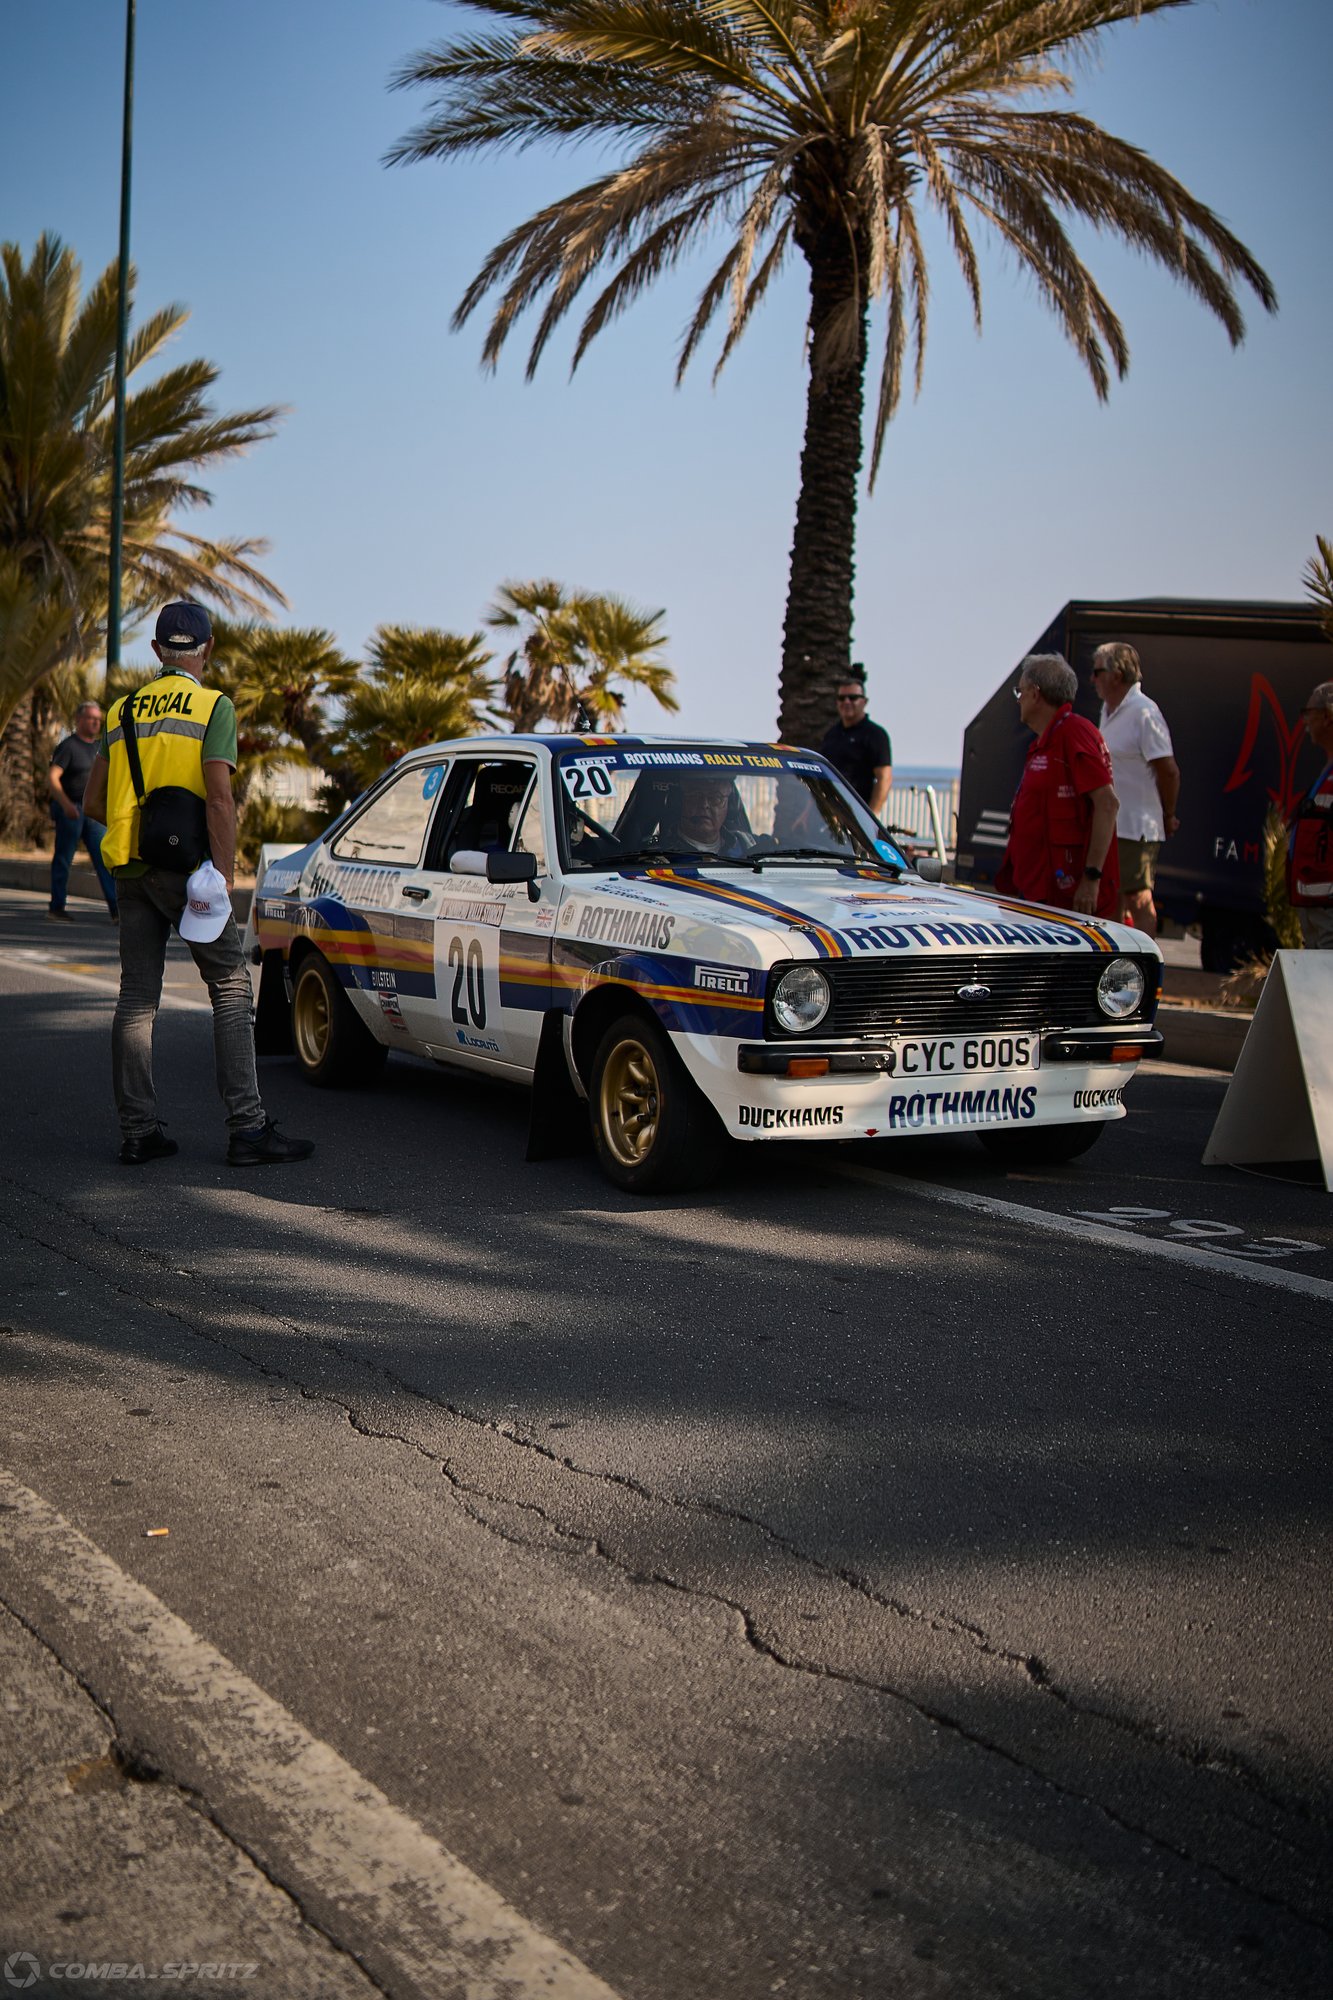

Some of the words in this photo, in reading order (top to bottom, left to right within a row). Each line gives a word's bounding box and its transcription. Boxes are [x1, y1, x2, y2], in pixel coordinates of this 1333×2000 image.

[623, 753, 704, 765] ROTHMANS
[703, 754, 744, 766] RALLY
[743, 755, 783, 769] TEAM
[787, 760, 822, 773] PIRELLI
[428, 772, 439, 791] 3
[490, 783, 526, 794] RECAR
[565, 766, 613, 798] 20
[881, 844, 897, 861] 3
[308, 862, 402, 909] ROTHMANS
[265, 902, 286, 919] PIRELLI
[576, 905, 676, 950] ROTHMANS
[838, 922, 1082, 951] ROTHMANS
[371, 971, 397, 989] BILSTEIN
[448, 936, 487, 1031] 20
[694, 965, 749, 994] PIRELLI
[902, 1041, 955, 1073] CYC
[963, 1037, 1030, 1069] 600S
[889, 1086, 1038, 1129] ROTHMANS
[1073, 1088, 1123, 1109] DUCKHA
[738, 1105, 844, 1129] DUCKHAMS
